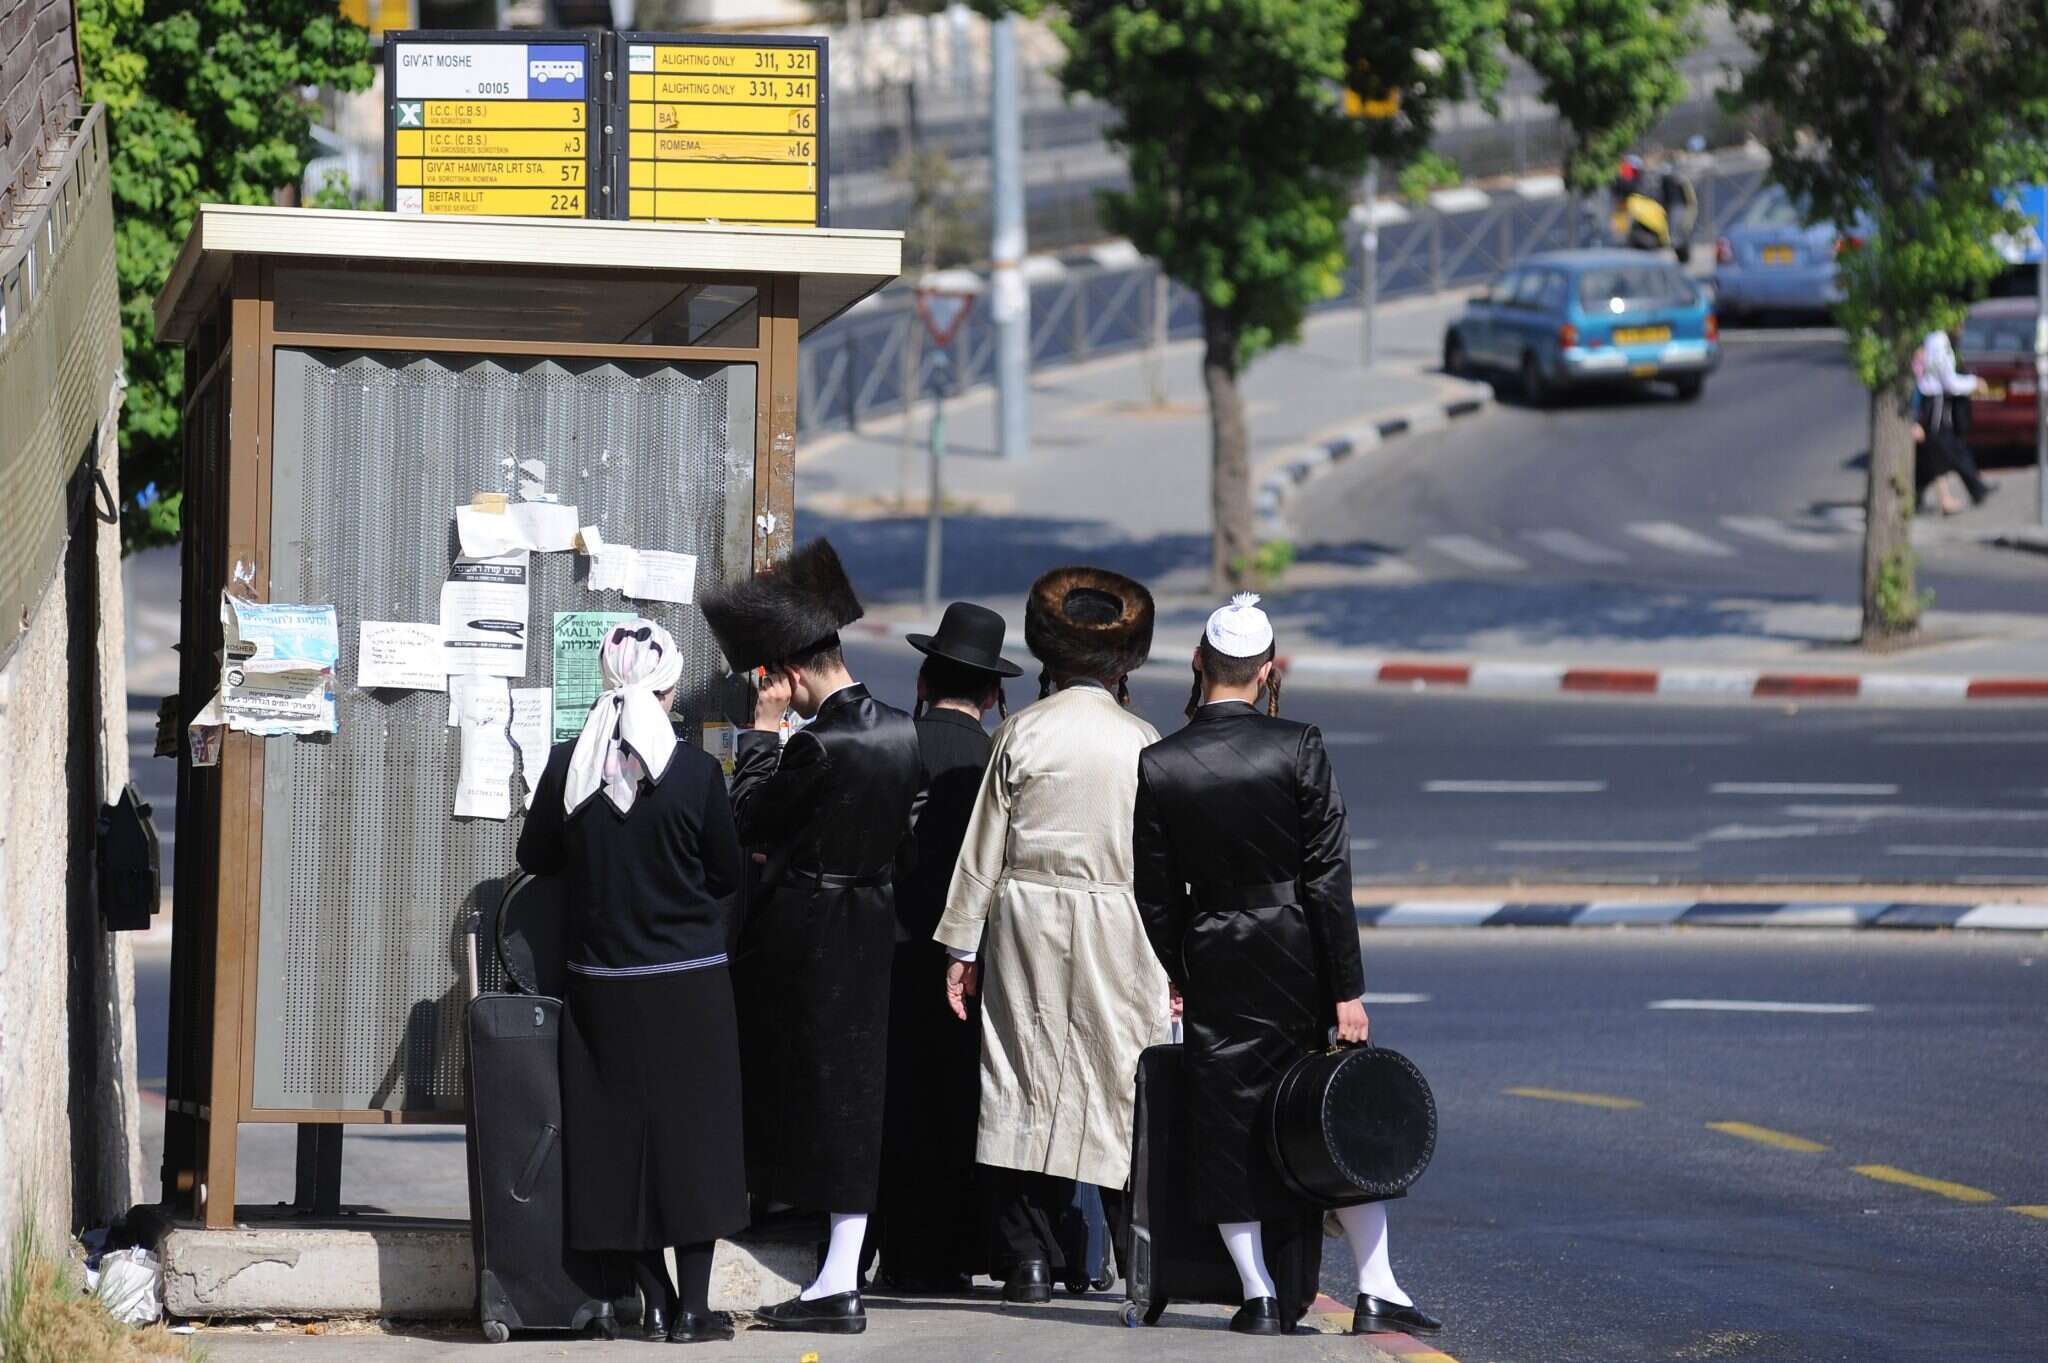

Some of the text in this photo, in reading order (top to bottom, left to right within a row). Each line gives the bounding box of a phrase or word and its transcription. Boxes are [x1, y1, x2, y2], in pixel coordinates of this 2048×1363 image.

[403, 54, 472, 68] GIV'AT MOSHE
[662, 52, 811, 71] ALIGHTING ONLY 311, 321
[478, 82, 510, 95] 00105
[662, 81, 811, 100] ALIGHTING ONLY 331, 341
[572, 107, 581, 123] 3
[796, 113, 810, 129] 16
[660, 139, 701, 151] ROMEMA
[426, 162, 580, 181] GIV'AT HAMIVTAR LRT STA. 57
[429, 191, 579, 210] BEITAR ILLIT 224
[559, 627, 591, 637] MALL
